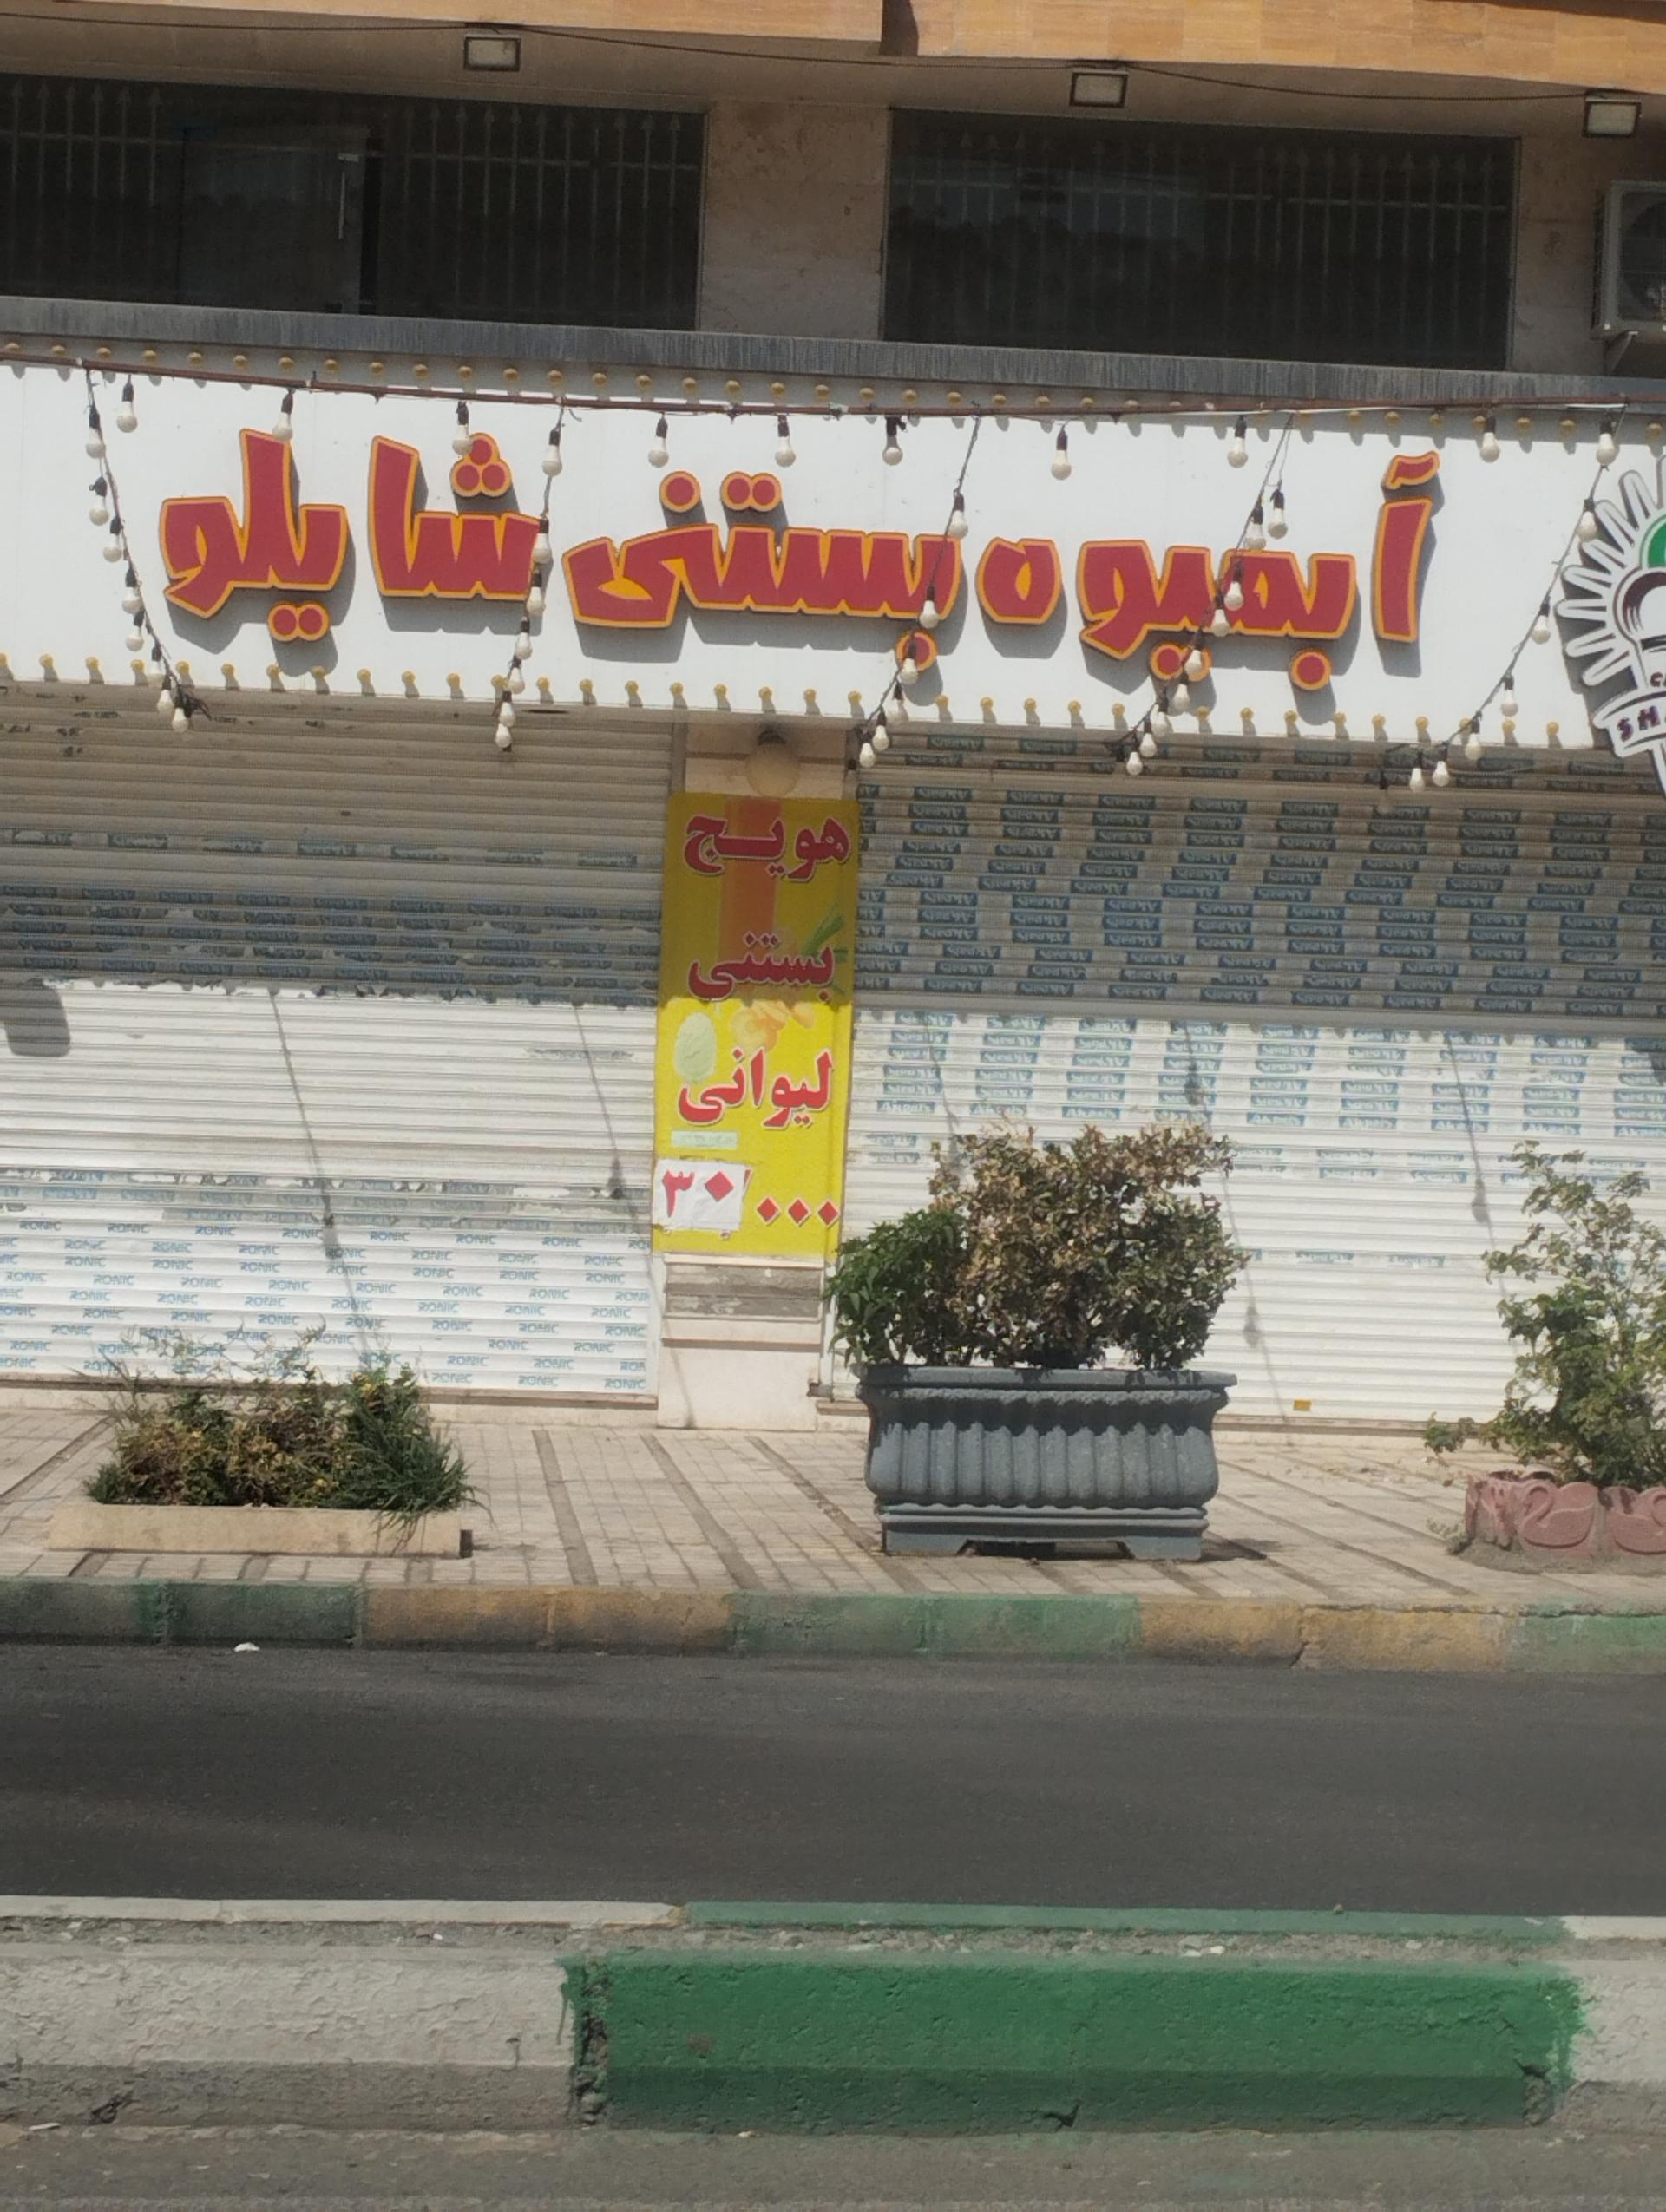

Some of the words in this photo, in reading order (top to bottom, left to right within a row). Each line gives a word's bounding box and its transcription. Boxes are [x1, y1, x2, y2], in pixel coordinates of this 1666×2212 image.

[684, 812, 851, 880] هویج
[687, 930, 836, 1004] بستنی
[677, 1045, 834, 1128] لیوانی
